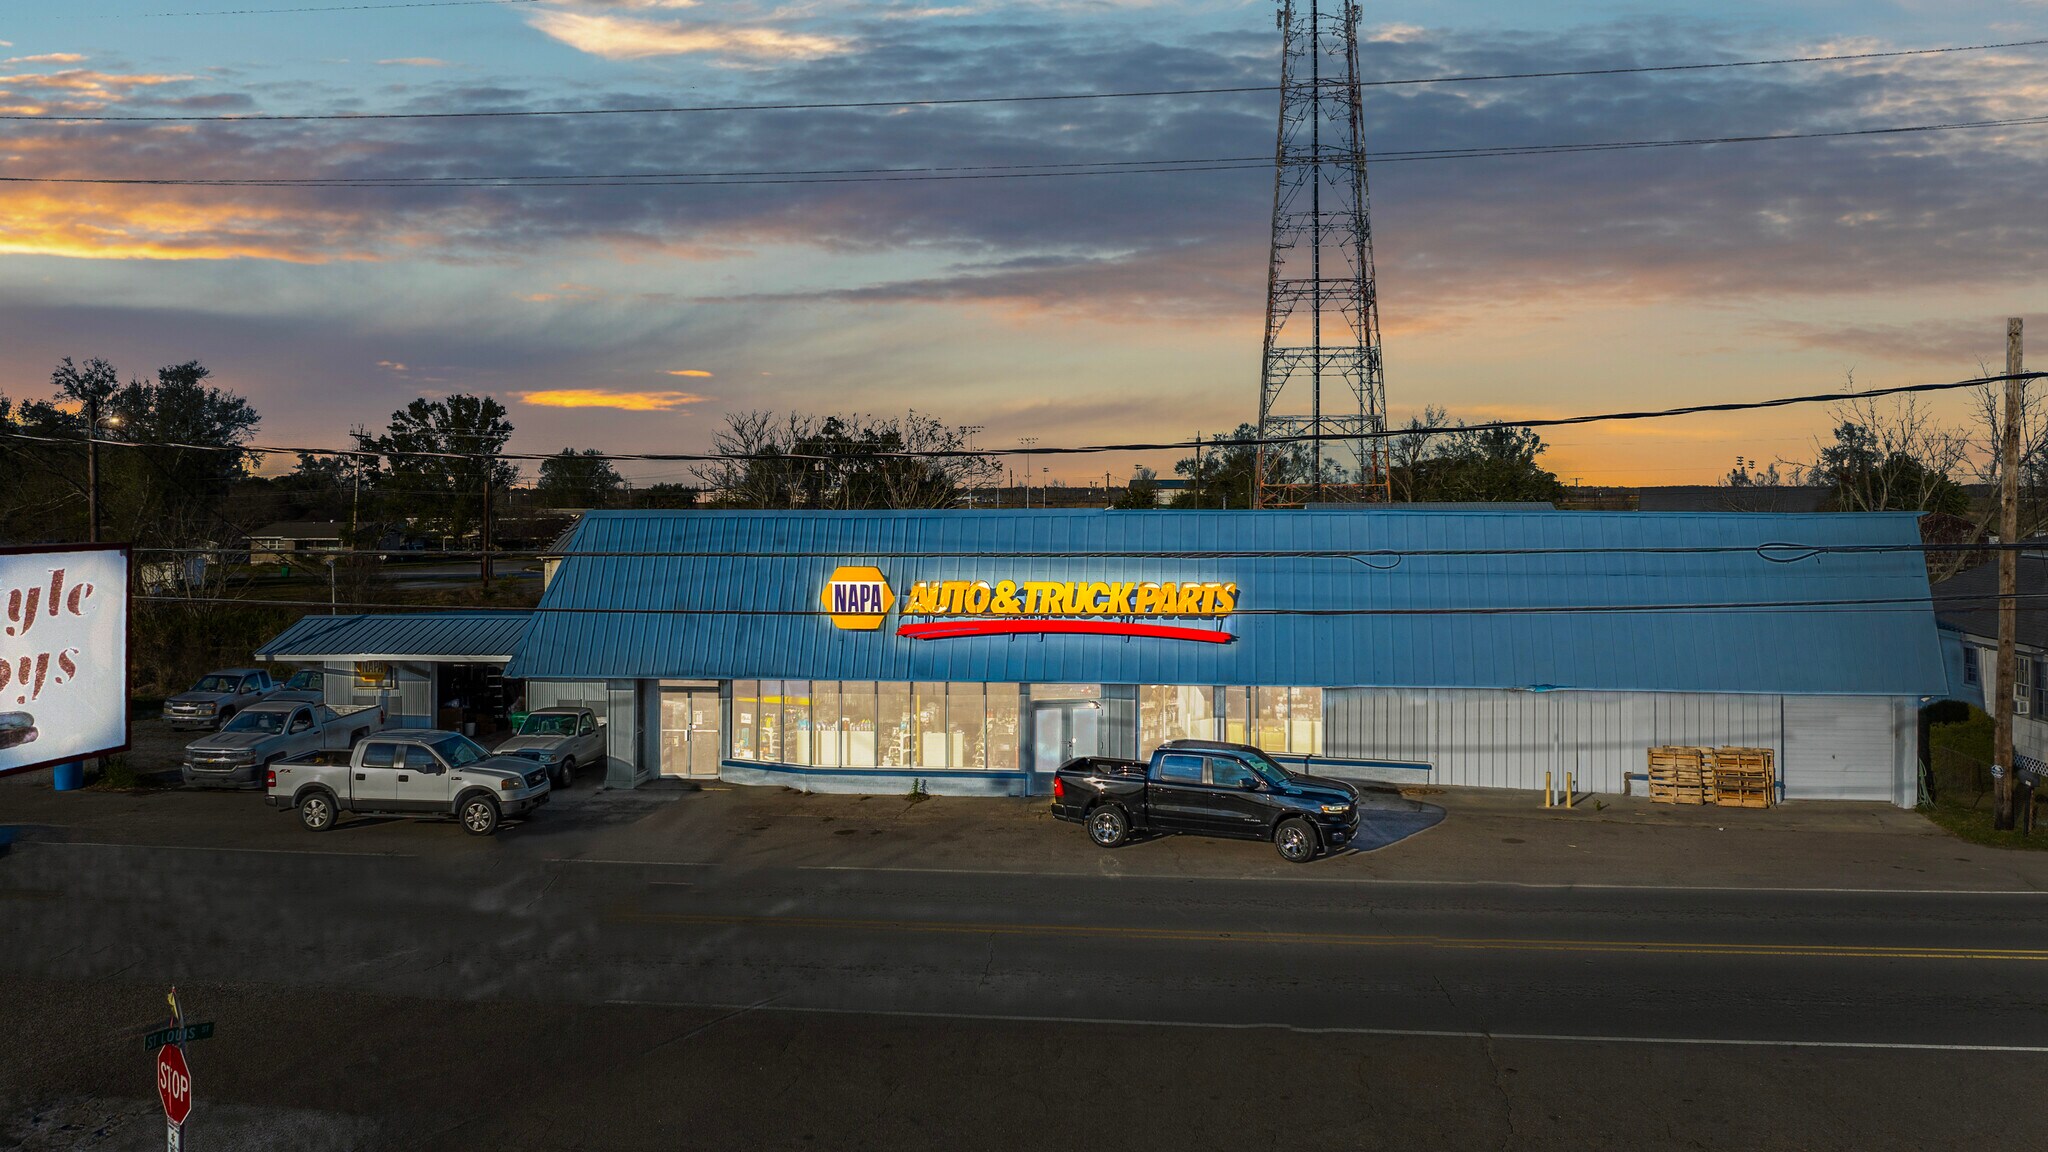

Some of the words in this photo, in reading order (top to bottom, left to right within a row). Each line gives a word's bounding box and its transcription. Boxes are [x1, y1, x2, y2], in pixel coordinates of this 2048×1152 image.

[2, 568, 95, 636] yle
[834, 584, 882, 612] NAPA
[902, 580, 991, 614] AUTO
[990, 579, 1022, 614] &
[1023, 580, 1136, 614] TRUCK
[1135, 581, 1237, 617] PARTS
[362, 660, 384, 673] NAPA
[147, 1034, 159, 1049] ST
[161, 1026, 196, 1044] LOUIS
[201, 1024, 210, 1033] ST
[160, 1061, 189, 1102] STOP
